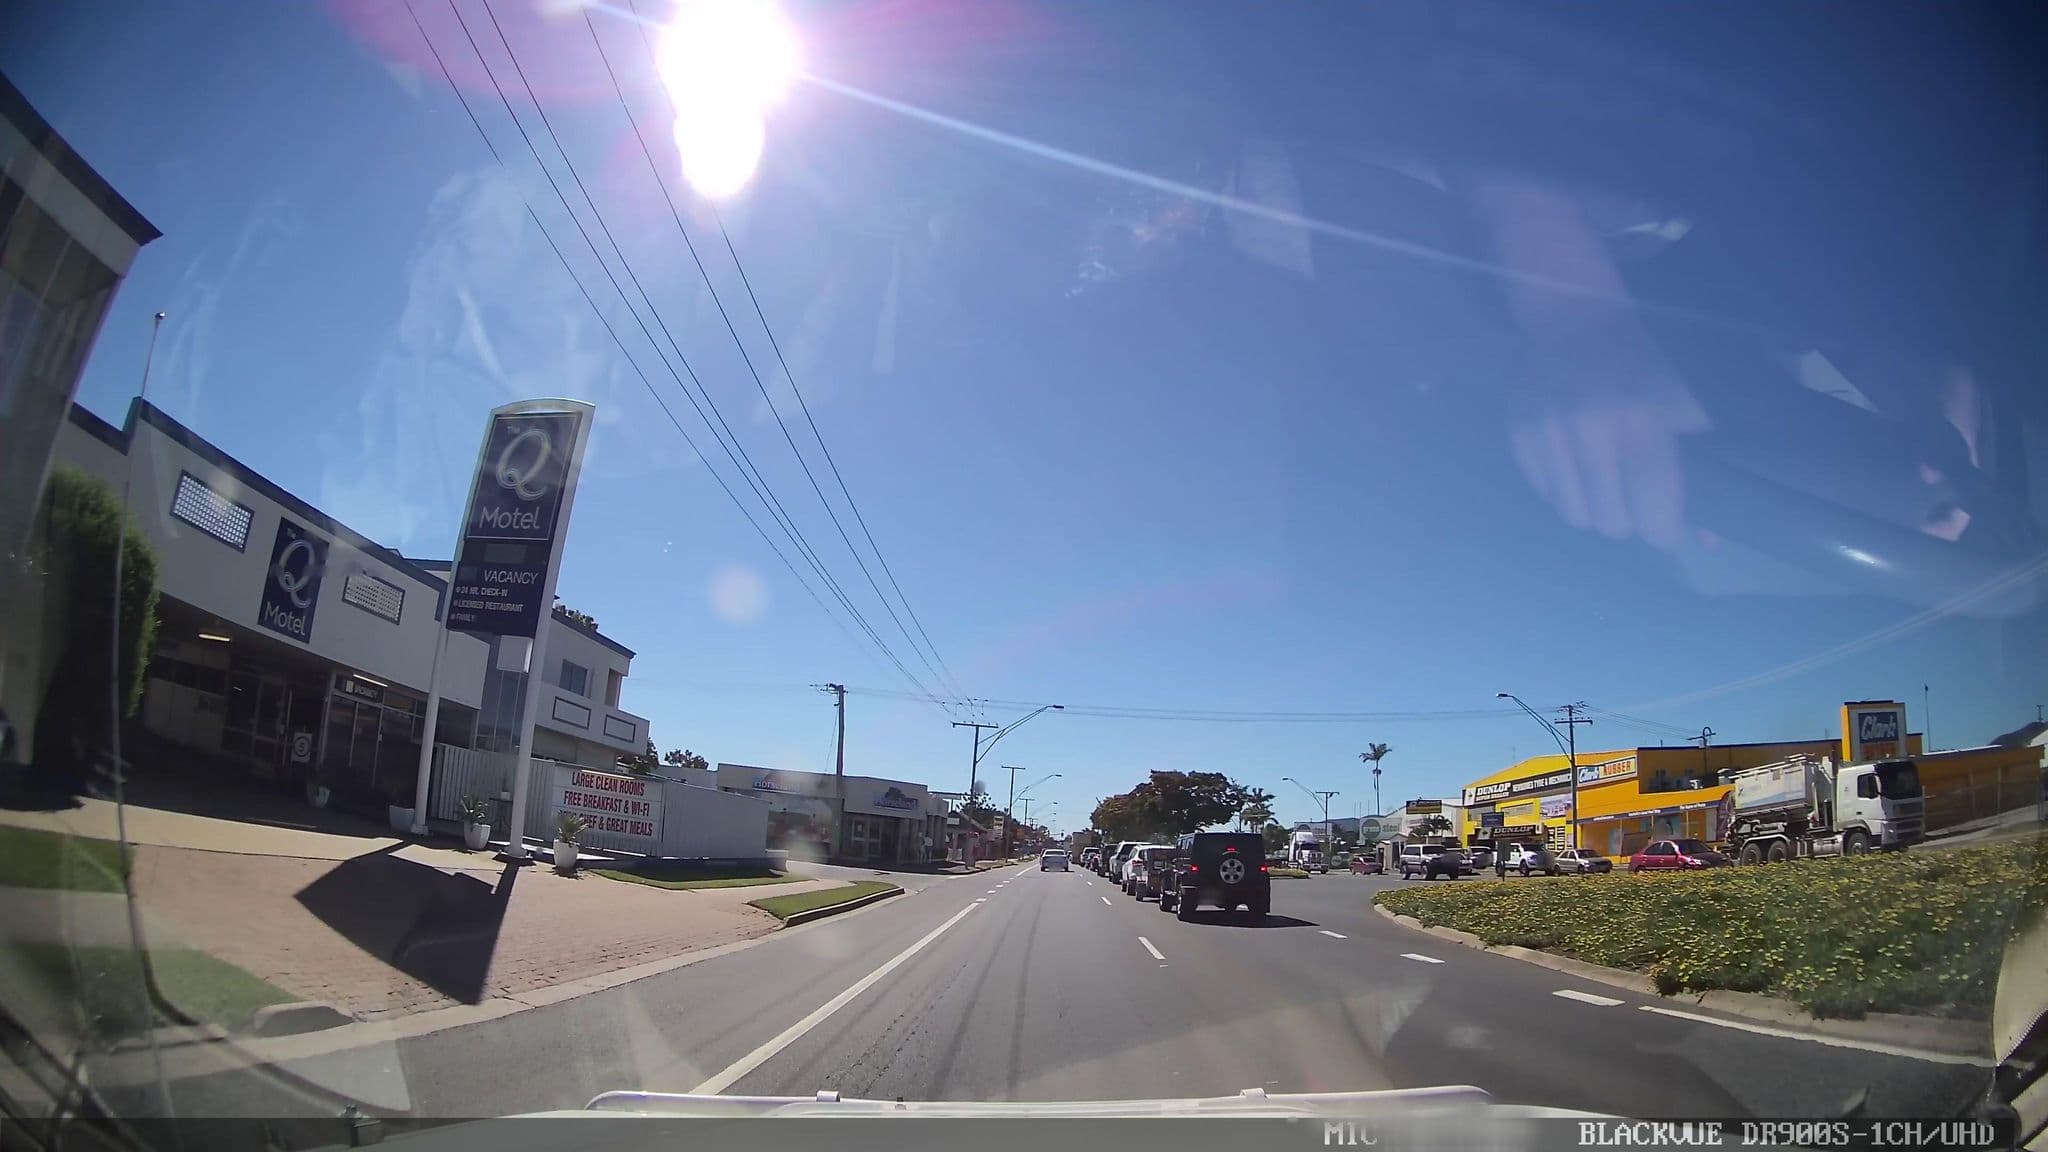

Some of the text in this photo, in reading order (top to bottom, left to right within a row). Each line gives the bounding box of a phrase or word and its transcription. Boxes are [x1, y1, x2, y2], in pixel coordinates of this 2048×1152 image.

[496, 430, 551, 500] Q
[480, 506, 540, 529] Motel
[278, 540, 315, 608] Q
[484, 569, 538, 585] VACANCY
[264, 601, 306, 636] Motel
[485, 601, 523, 613] RESTAURANT
[1861, 715, 1896, 740] Clark
[1604, 761, 1631, 776] RUBBER
[572, 772, 645, 796] LARGE CLEAN ROOMS
[1477, 782, 1511, 796] DUNLOP
[564, 791, 582, 806] FREE
[583, 794, 622, 813] BREAKFAST
[624, 800, 629, 814] &
[631, 801, 650, 817] WI-FI
[599, 817, 605, 830] &
[607, 817, 628, 834] GREAT
[630, 819, 653, 837] MEALS
[1494, 825, 1534, 834] DUNLOP
